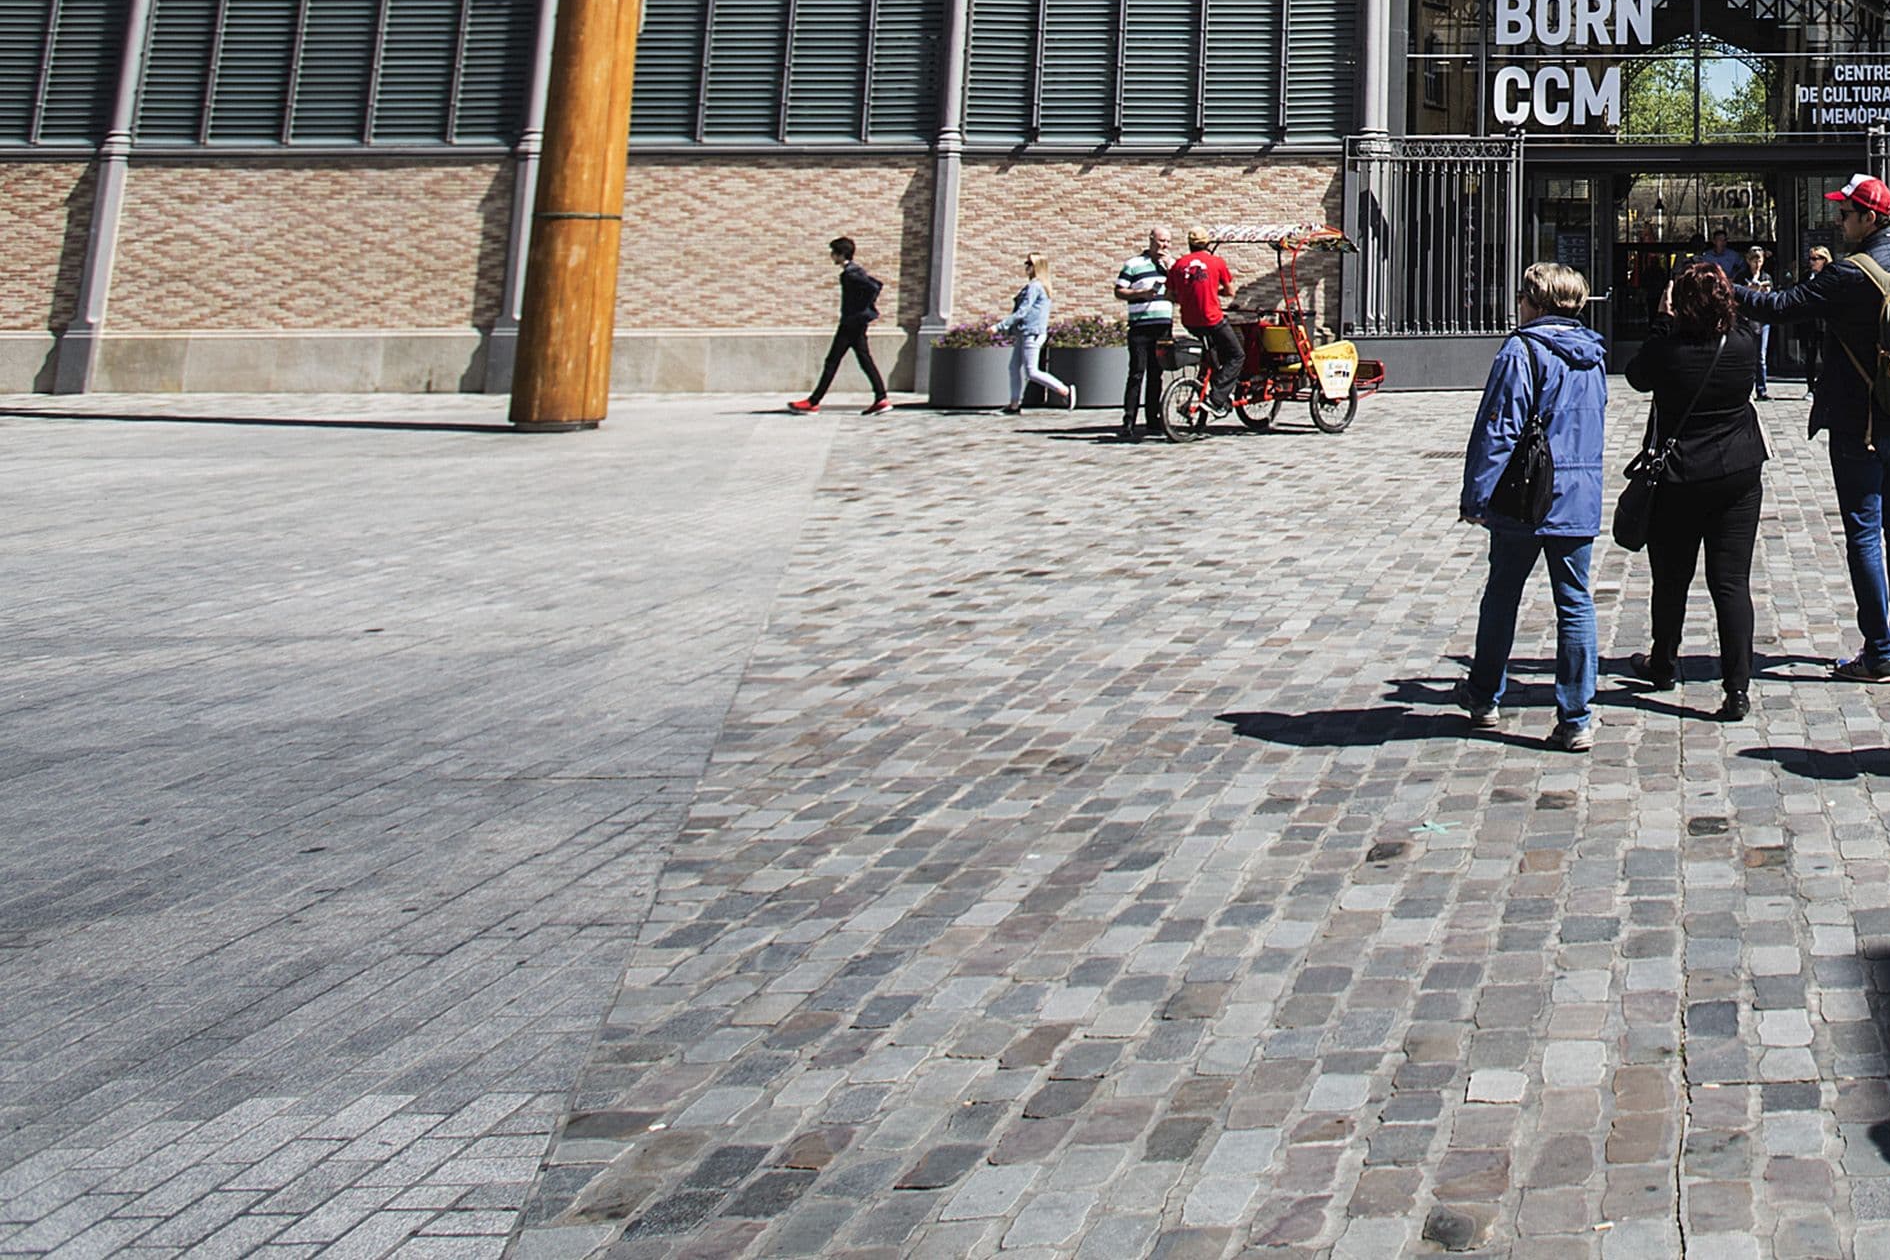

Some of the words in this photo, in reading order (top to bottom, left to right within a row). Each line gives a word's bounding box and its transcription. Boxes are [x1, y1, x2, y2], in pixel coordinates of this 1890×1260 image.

[1493, 65, 1621, 126] CCM
[1799, 86, 1818, 103] DE
[1812, 108, 1817, 124] I
